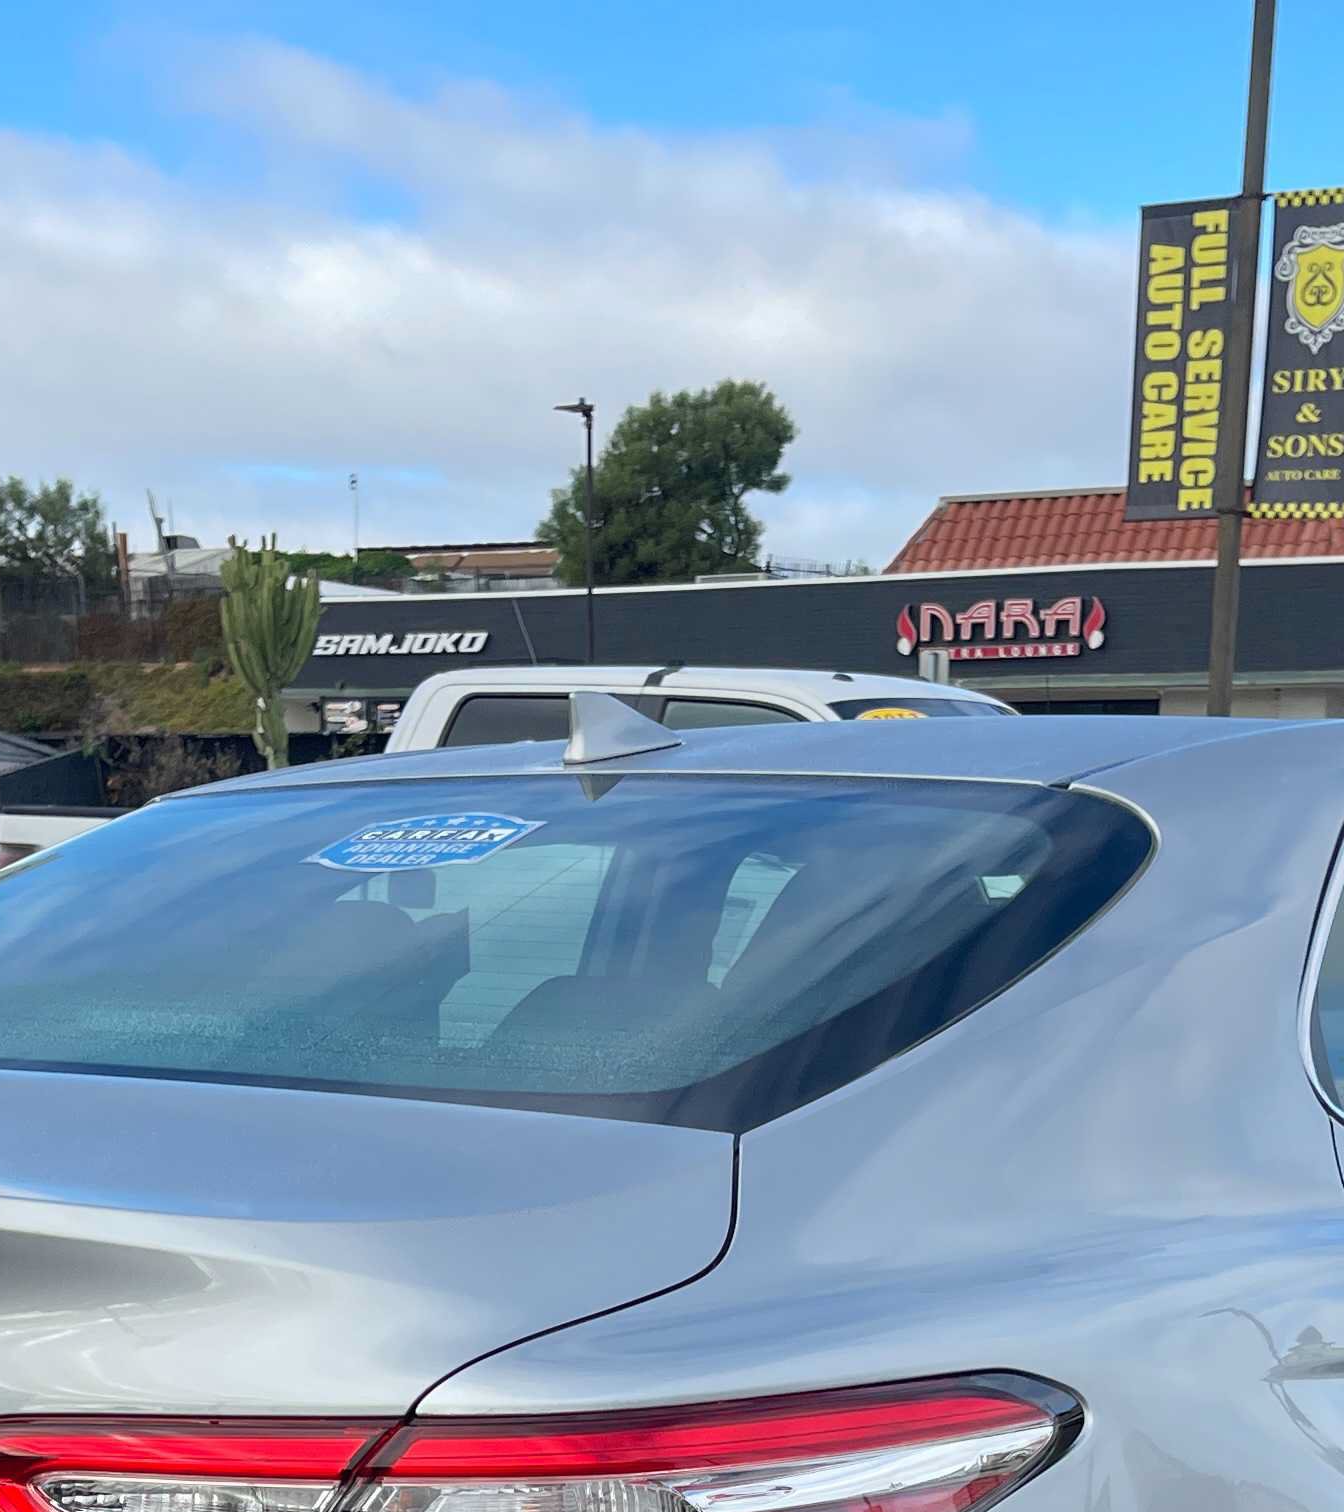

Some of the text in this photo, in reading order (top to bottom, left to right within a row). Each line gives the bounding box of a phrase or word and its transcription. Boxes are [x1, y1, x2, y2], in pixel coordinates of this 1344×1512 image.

[1138, 243, 1186, 484] AUTO CARE
[1177, 208, 1230, 512] FULL SERVICE
[1296, 402, 1322, 424] &
[1266, 432, 1344, 459] SONS
[1264, 467, 1342, 483] AUTO CARE
[919, 596, 1082, 642] NARA
[312, 632, 489, 656] SAMJOKO
[998, 644, 1075, 658] LOUNGE
[361, 828, 509, 842] CARFAX
[343, 842, 475, 854] ADVANTAGE
[344, 853, 437, 865] DEALER
